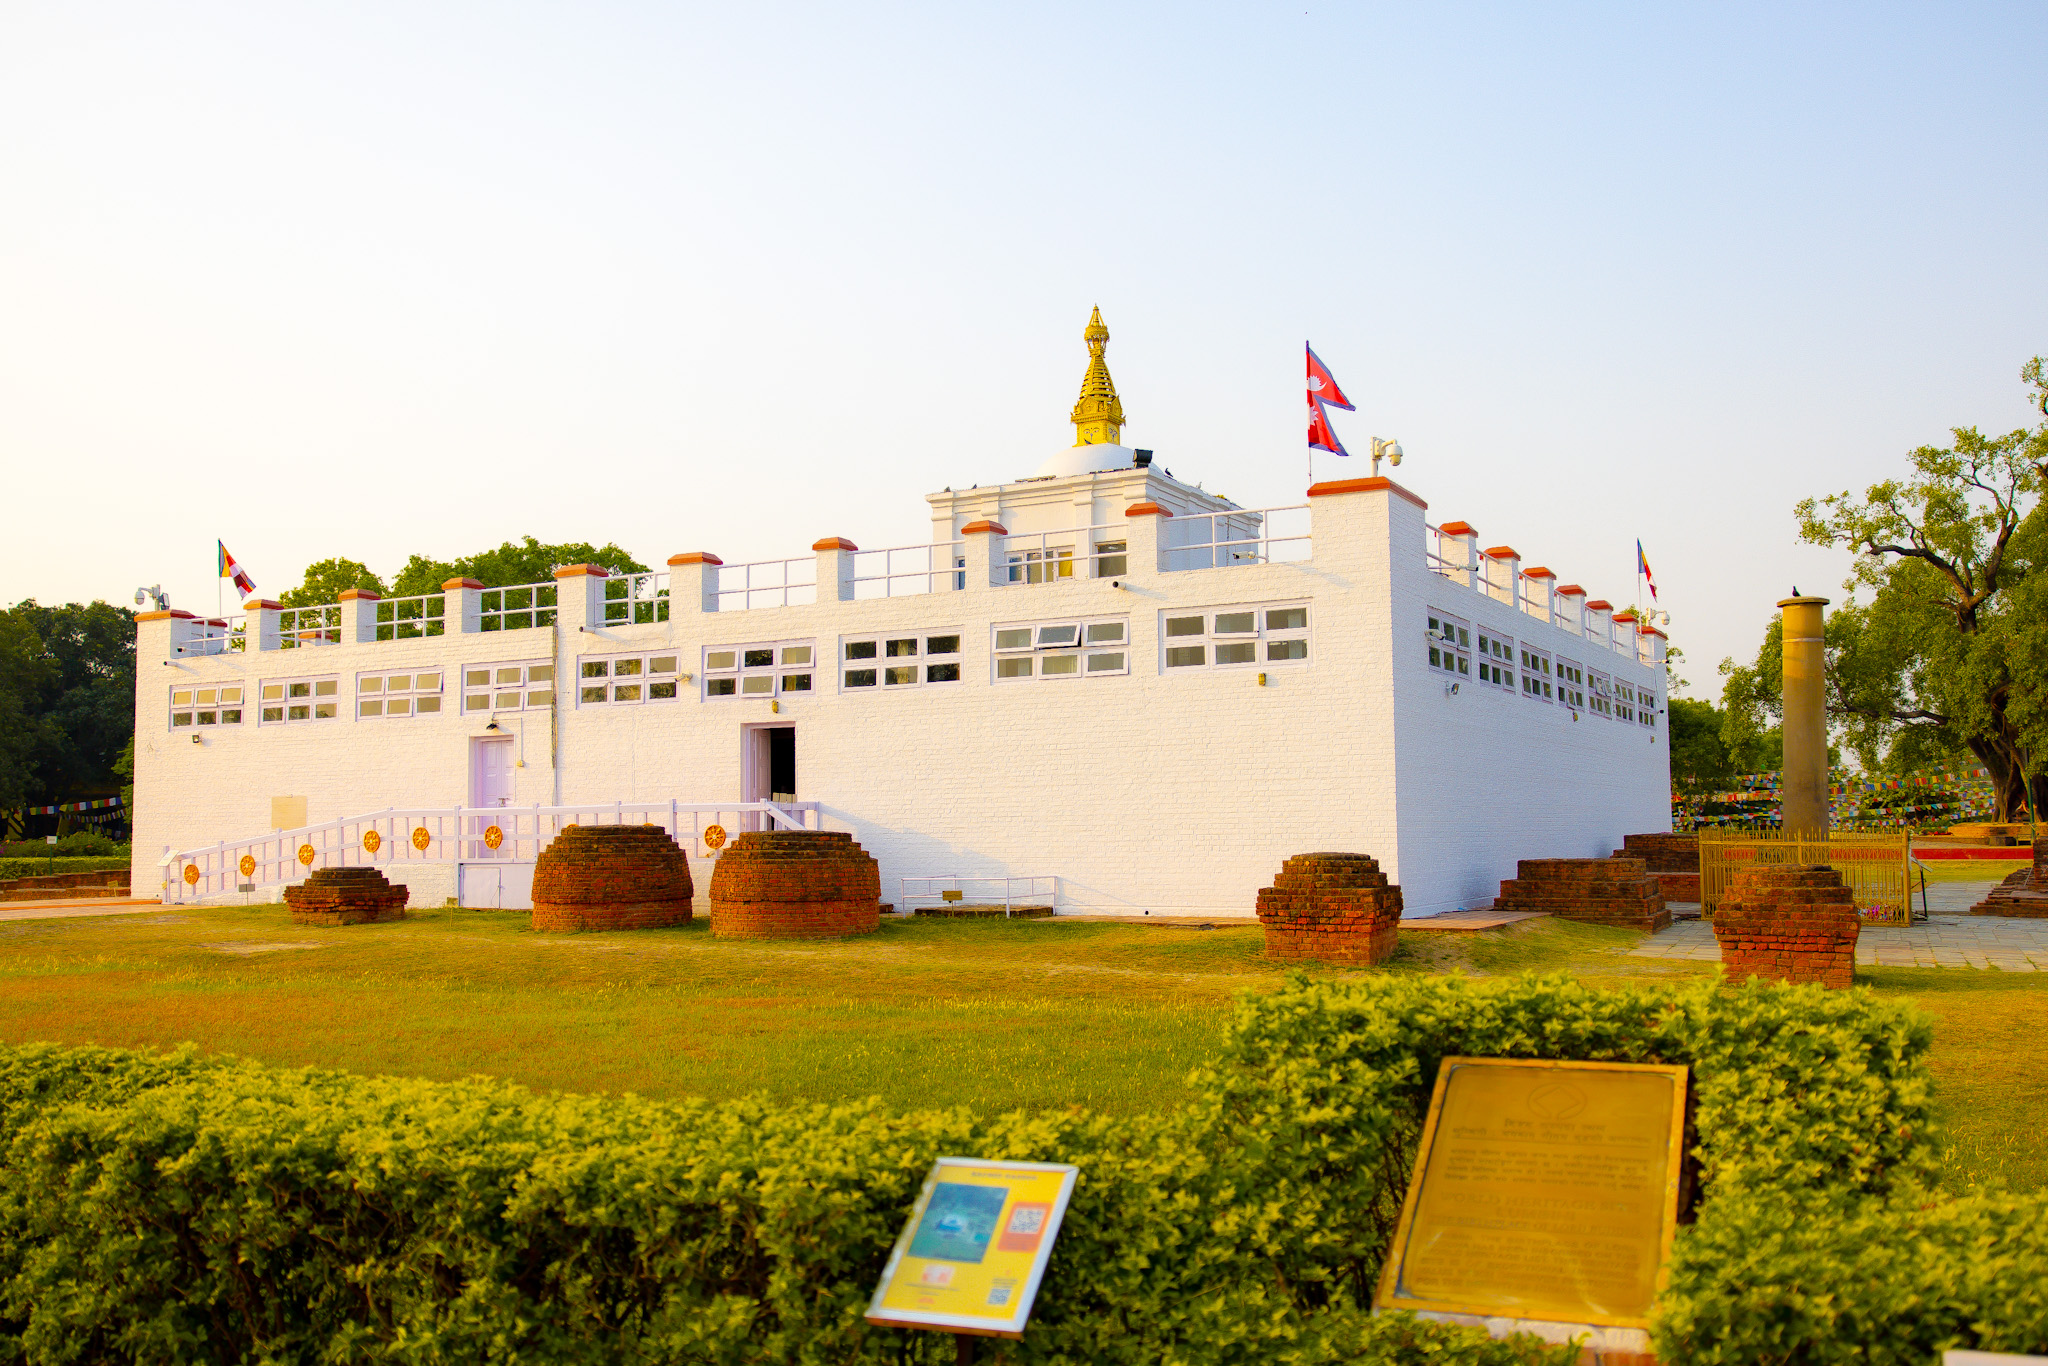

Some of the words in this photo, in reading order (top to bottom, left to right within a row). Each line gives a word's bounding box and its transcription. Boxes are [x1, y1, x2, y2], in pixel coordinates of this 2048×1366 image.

[1439, 1190, 1501, 1205] WORLD
[1504, 1194, 1596, 1212] HERITAGE
[1552, 1221, 1586, 1234] LORD
